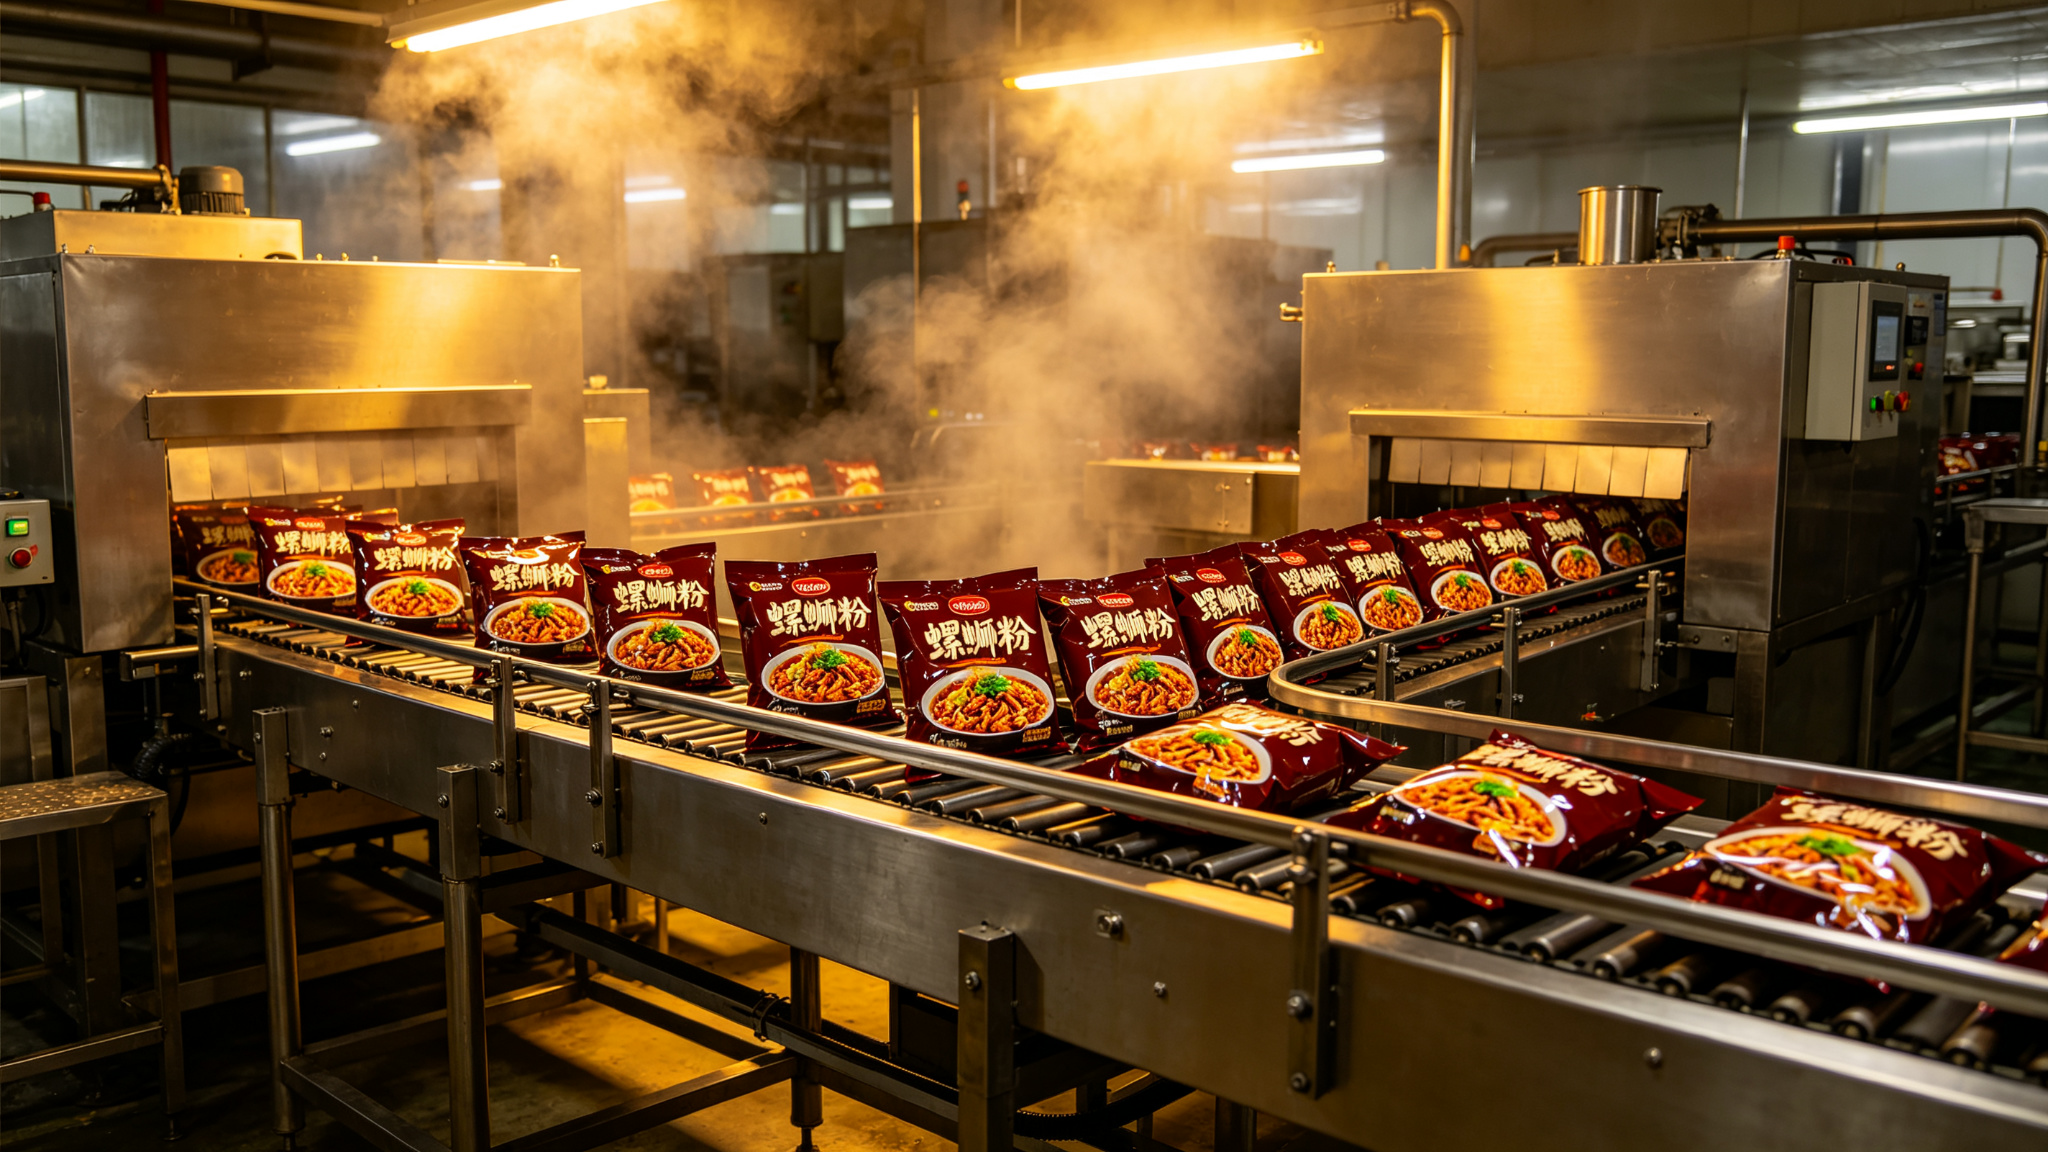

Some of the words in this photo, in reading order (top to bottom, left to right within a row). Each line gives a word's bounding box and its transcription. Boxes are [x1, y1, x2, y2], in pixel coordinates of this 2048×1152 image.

[490, 562, 581, 592] 螺蛳粉
[613, 579, 710, 613] 螺蛳粉
[766, 596, 872, 637] 螺蛳粉
[1080, 607, 1176, 648] 螺蛳粉
[924, 616, 1037, 660] 螺蛳粉
